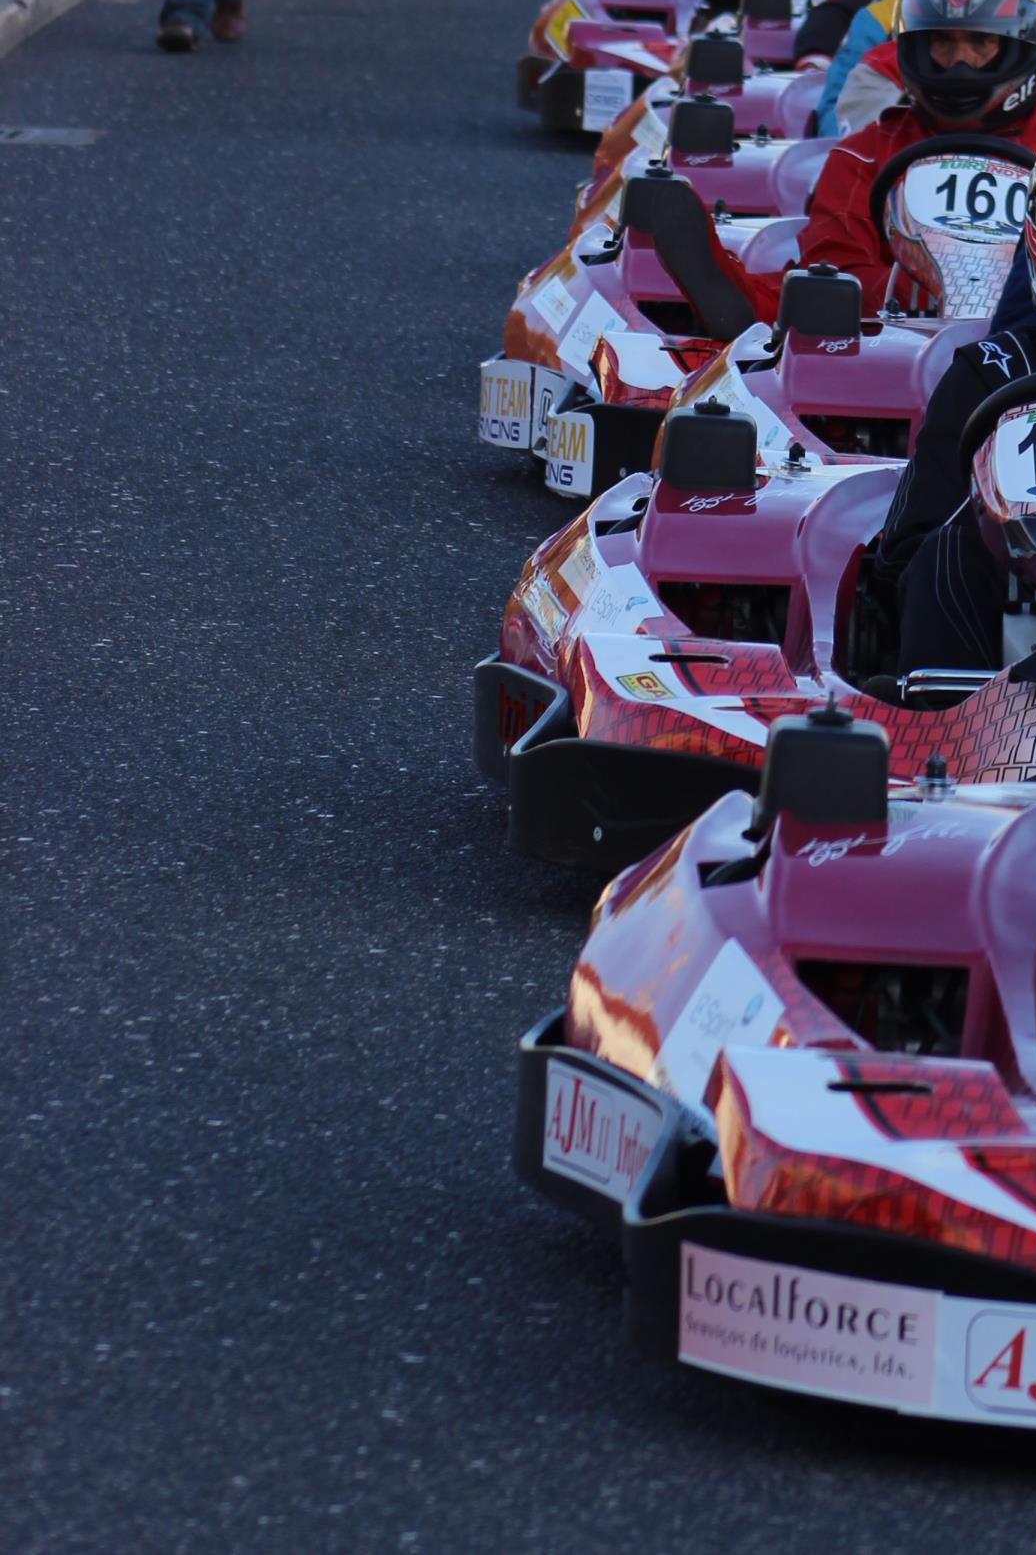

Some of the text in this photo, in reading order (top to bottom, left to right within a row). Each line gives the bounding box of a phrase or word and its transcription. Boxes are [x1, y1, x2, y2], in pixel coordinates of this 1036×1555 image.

[1002, 74, 1036, 111] elf
[936, 171, 1029, 228] 160
[496, 377, 528, 419] TEAM
[546, 1075, 597, 1154] AJM
